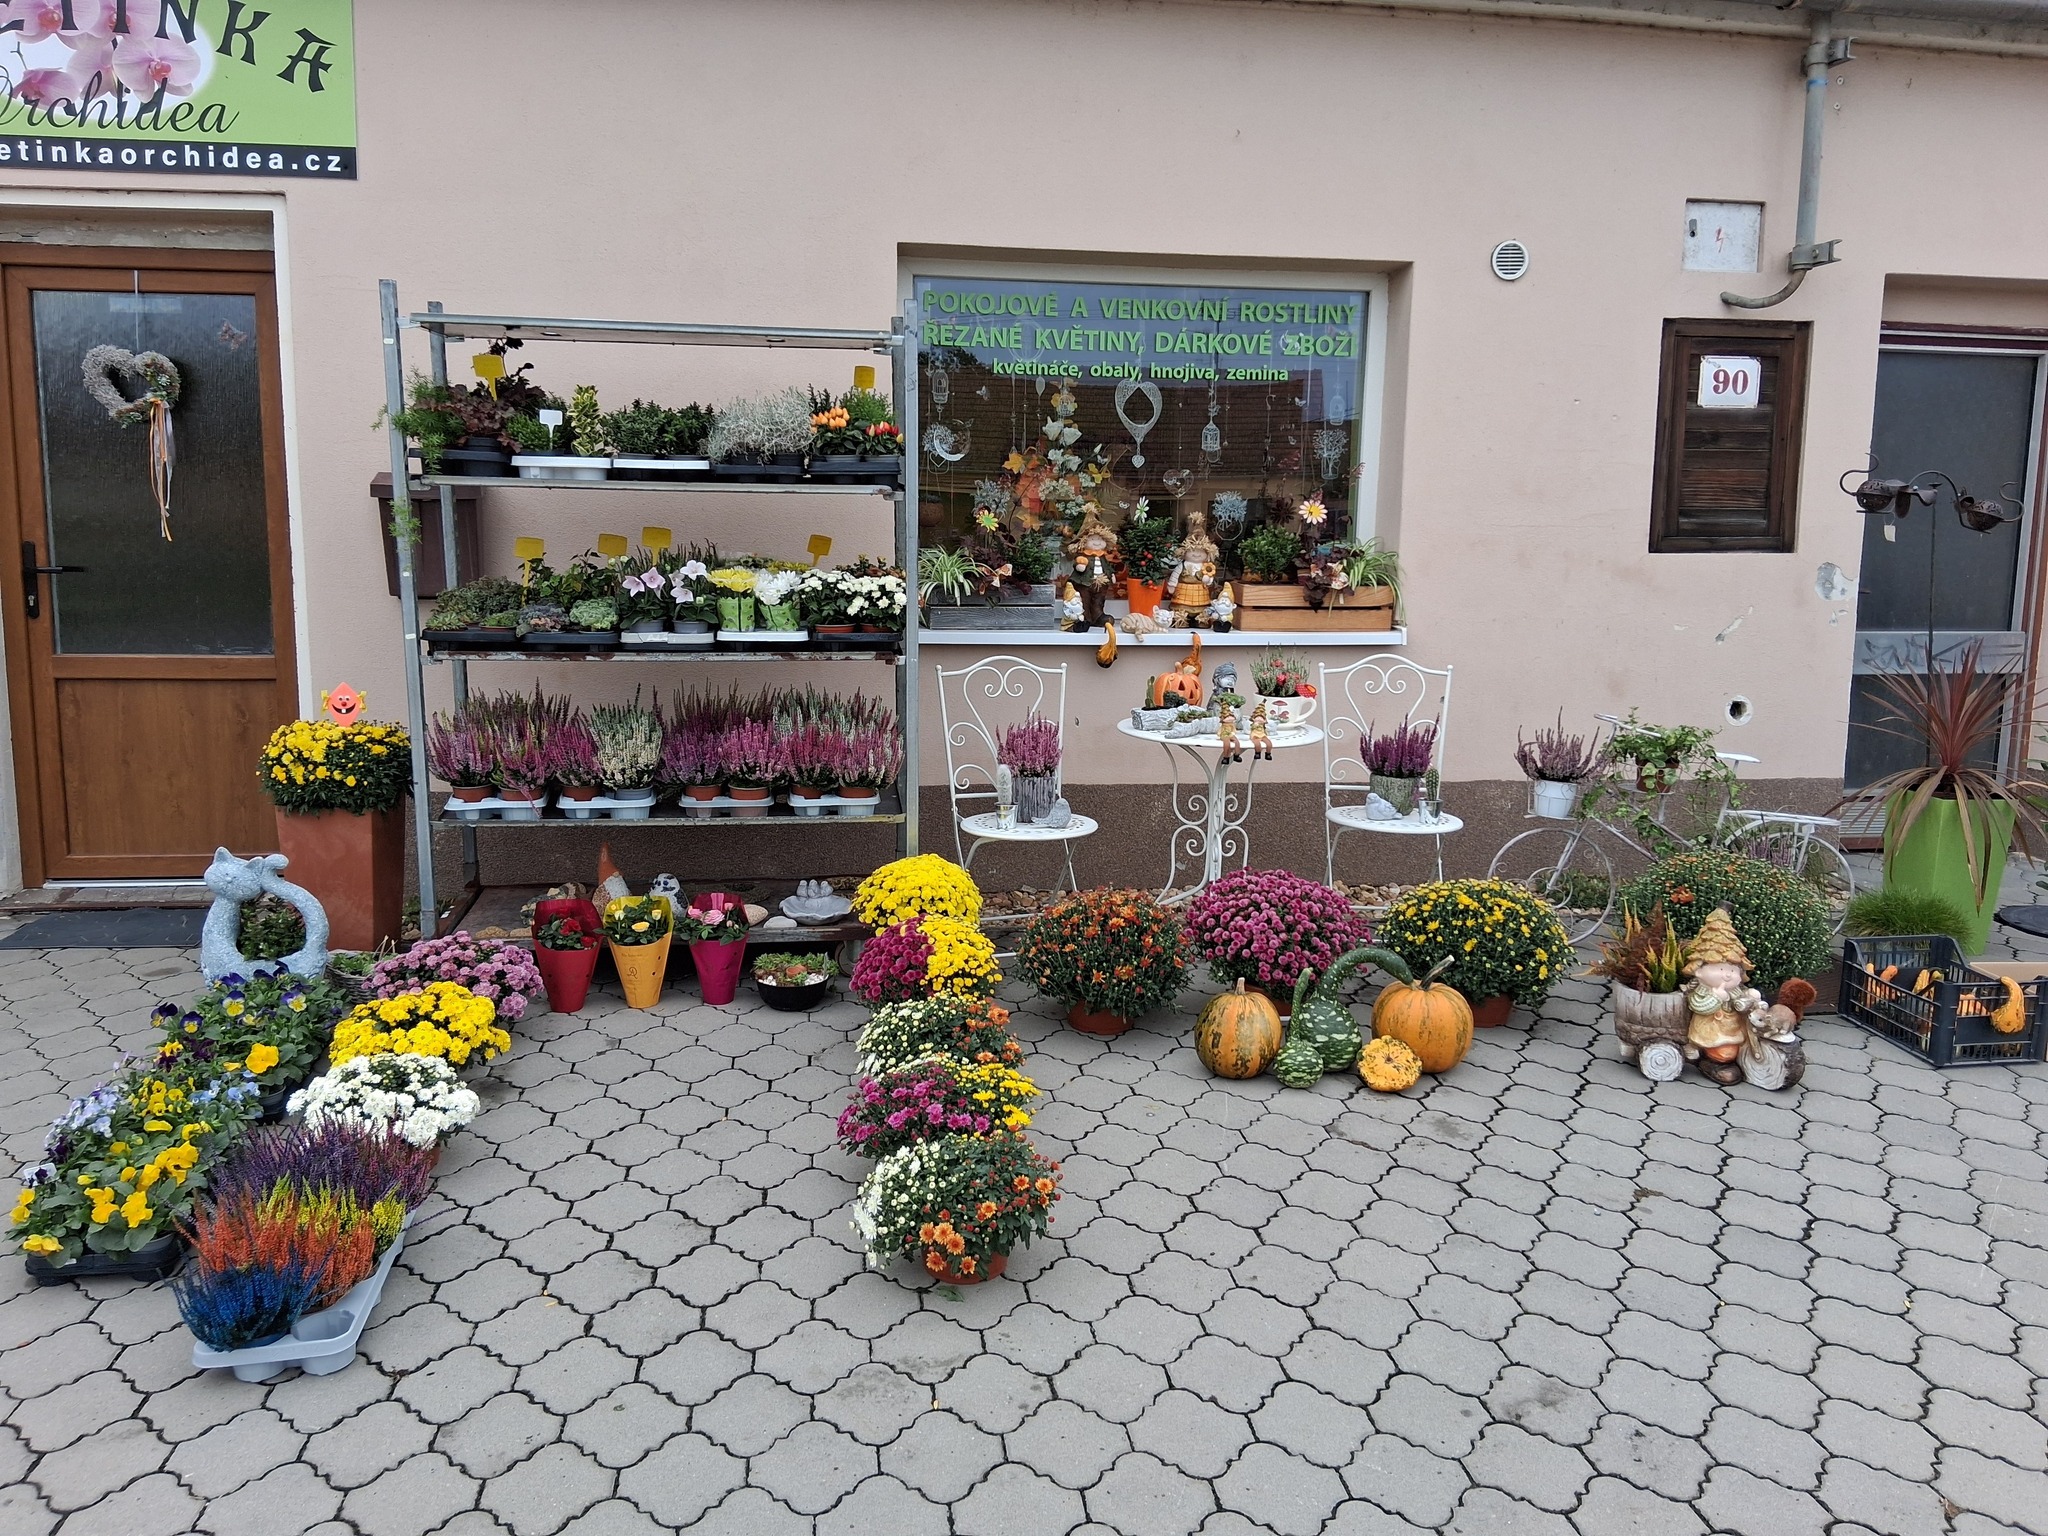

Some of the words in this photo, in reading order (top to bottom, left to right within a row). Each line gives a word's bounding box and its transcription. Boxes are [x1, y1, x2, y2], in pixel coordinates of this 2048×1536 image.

[0, 138, 343, 173] etinkaorchidea.cz
[923, 290, 1059, 317] POKOJOVÉ
[1071, 296, 1089, 318] A
[1100, 297, 1228, 322] VENKOVNÍ
[1240, 301, 1359, 324] ROSTLINY
[923, 319, 1023, 349] ŘEZANÉ
[1035, 325, 1145, 355] KVĚTINY,
[1155, 327, 1272, 356] DÁRKOVÉ
[1283, 330, 1359, 359] ZBOŽÍ
[993, 358, 1083, 379] květináče,
[1090, 361, 1143, 382] obaly,
[1150, 363, 1220, 383] hnojiva,
[1226, 365, 1289, 381] zemina
[1712, 368, 1749, 396] 90
